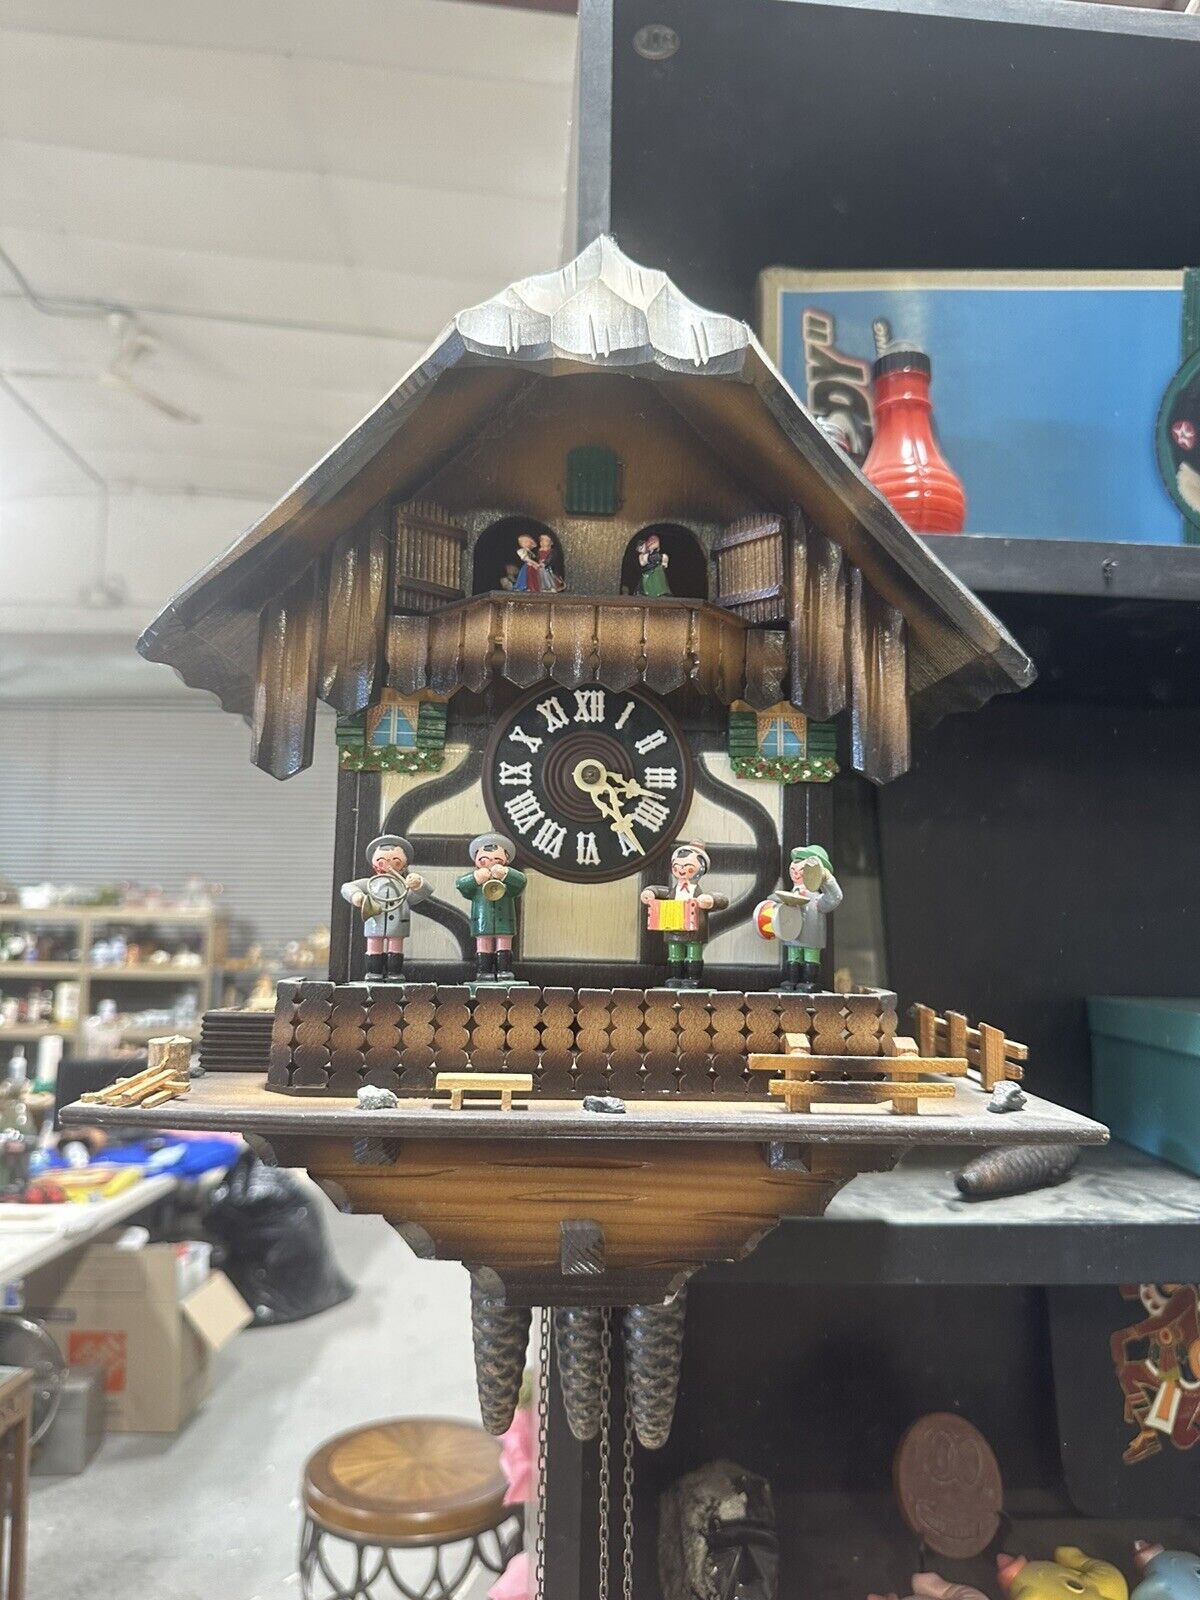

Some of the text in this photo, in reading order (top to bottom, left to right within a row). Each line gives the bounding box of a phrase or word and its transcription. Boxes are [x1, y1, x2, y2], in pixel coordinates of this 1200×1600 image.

[536, 696, 570, 733] XI
[574, 689, 605, 722] XII
[615, 701, 636, 730] I
[508, 725, 543, 753] X
[634, 729, 668, 755] II
[499, 761, 532, 785] IX
[644, 766, 678, 789] III
[504, 788, 546, 834] VIII
[631, 796, 670, 833] IIII
[531, 818, 568, 859] VII
[576, 831, 601, 866] VI
